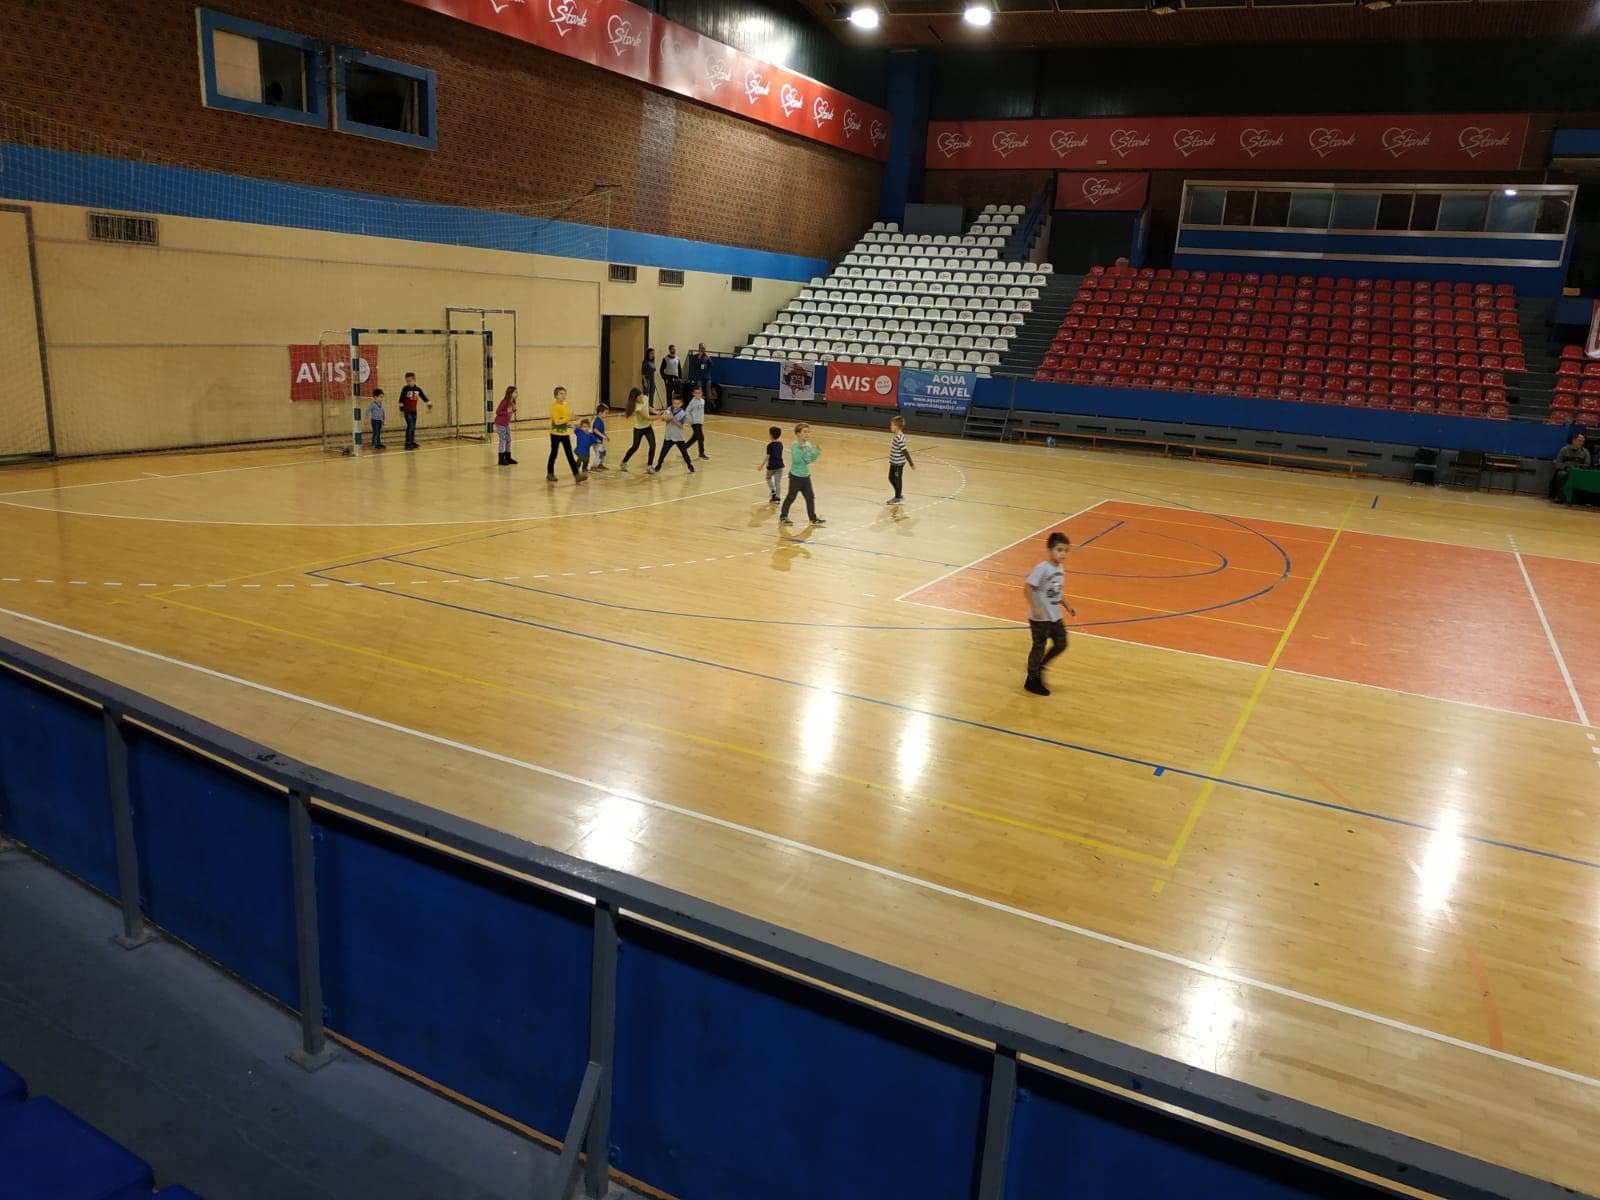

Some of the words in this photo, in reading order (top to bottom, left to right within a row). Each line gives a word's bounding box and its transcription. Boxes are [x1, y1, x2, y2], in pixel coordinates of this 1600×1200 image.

[550, 5, 588, 28] Stark
[608, 27, 642, 48] Stark
[745, 79, 771, 97] Stark
[939, 136, 974, 150] Stark
[993, 135, 1030, 150] Stark
[1051, 132, 1088, 150] Stark
[1111, 132, 1151, 150] Stark
[1174, 132, 1216, 150] Stark
[1240, 131, 1284, 150] Stark
[1311, 132, 1356, 150] Stark
[1384, 131, 1431, 150] Stark
[1459, 131, 1511, 150] Stark
[1083, 180, 1121, 198] Stark
[296, 362, 346, 383] AVIS
[932, 374, 966, 385] AQUA
[830, 374, 871, 392] AVIS
[925, 385, 970, 398] TRAVEL
